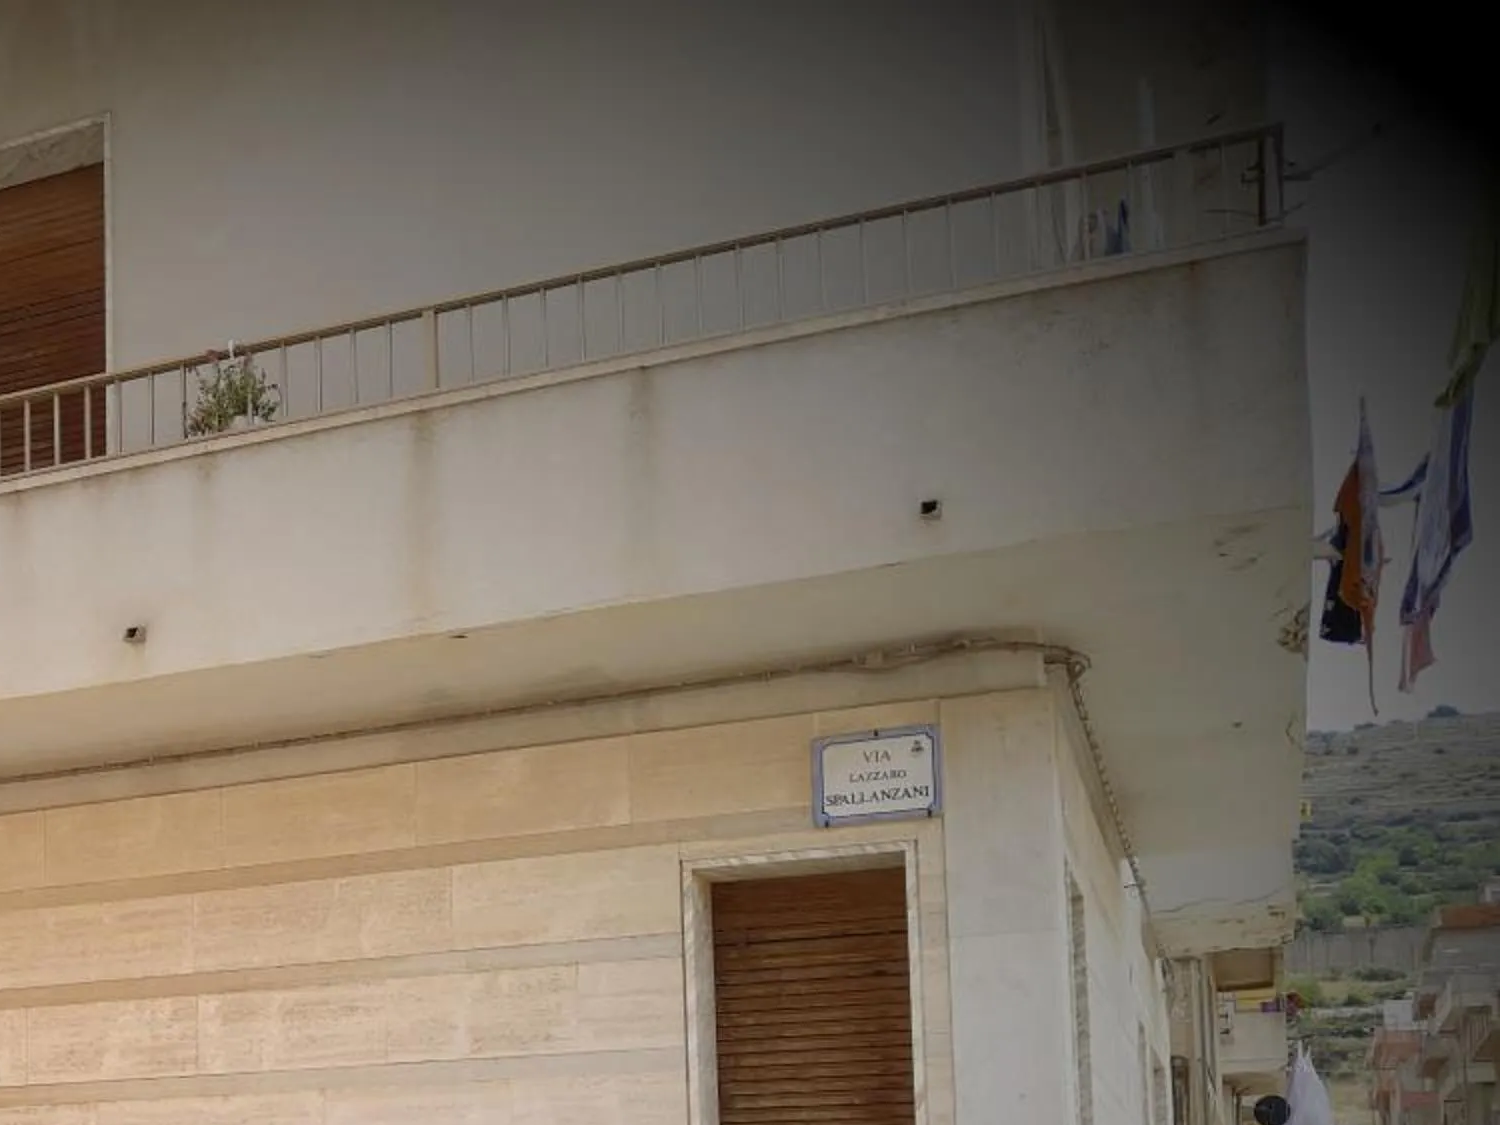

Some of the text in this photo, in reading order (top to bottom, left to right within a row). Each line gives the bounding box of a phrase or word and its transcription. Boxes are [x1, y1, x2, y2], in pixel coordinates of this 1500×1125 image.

[863, 750, 892, 763] VIA
[849, 769, 907, 783] LAZZARO
[825, 785, 930, 807] SPALLANZANI
